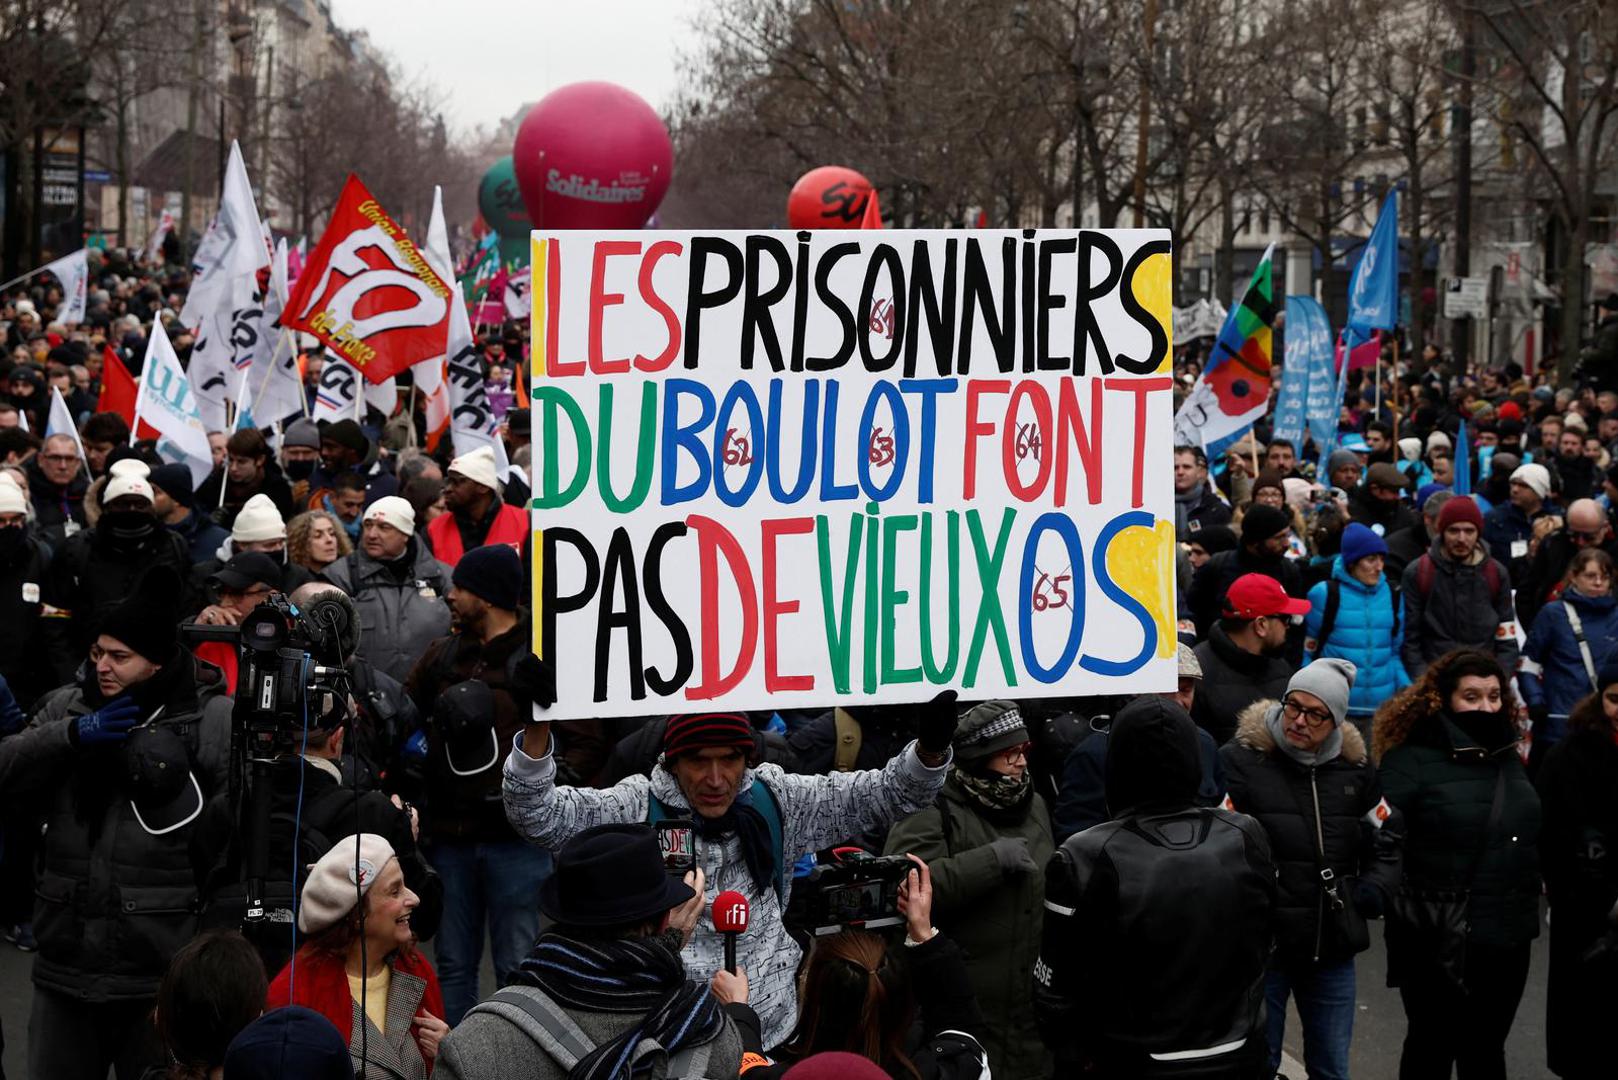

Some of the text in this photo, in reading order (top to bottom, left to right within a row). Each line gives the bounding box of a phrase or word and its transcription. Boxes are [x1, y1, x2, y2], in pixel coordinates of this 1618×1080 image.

[546, 238, 684, 377] LES
[531, 380, 658, 514] DU
[661, 377, 959, 507] BOULOT
[962, 376, 1174, 508] FONT
[542, 521, 694, 703] PAS
[685, 514, 816, 701] DE
[1018, 510, 1159, 684] OS
[1032, 572, 1072, 612] 65
[726, 904, 746, 925] rfi
